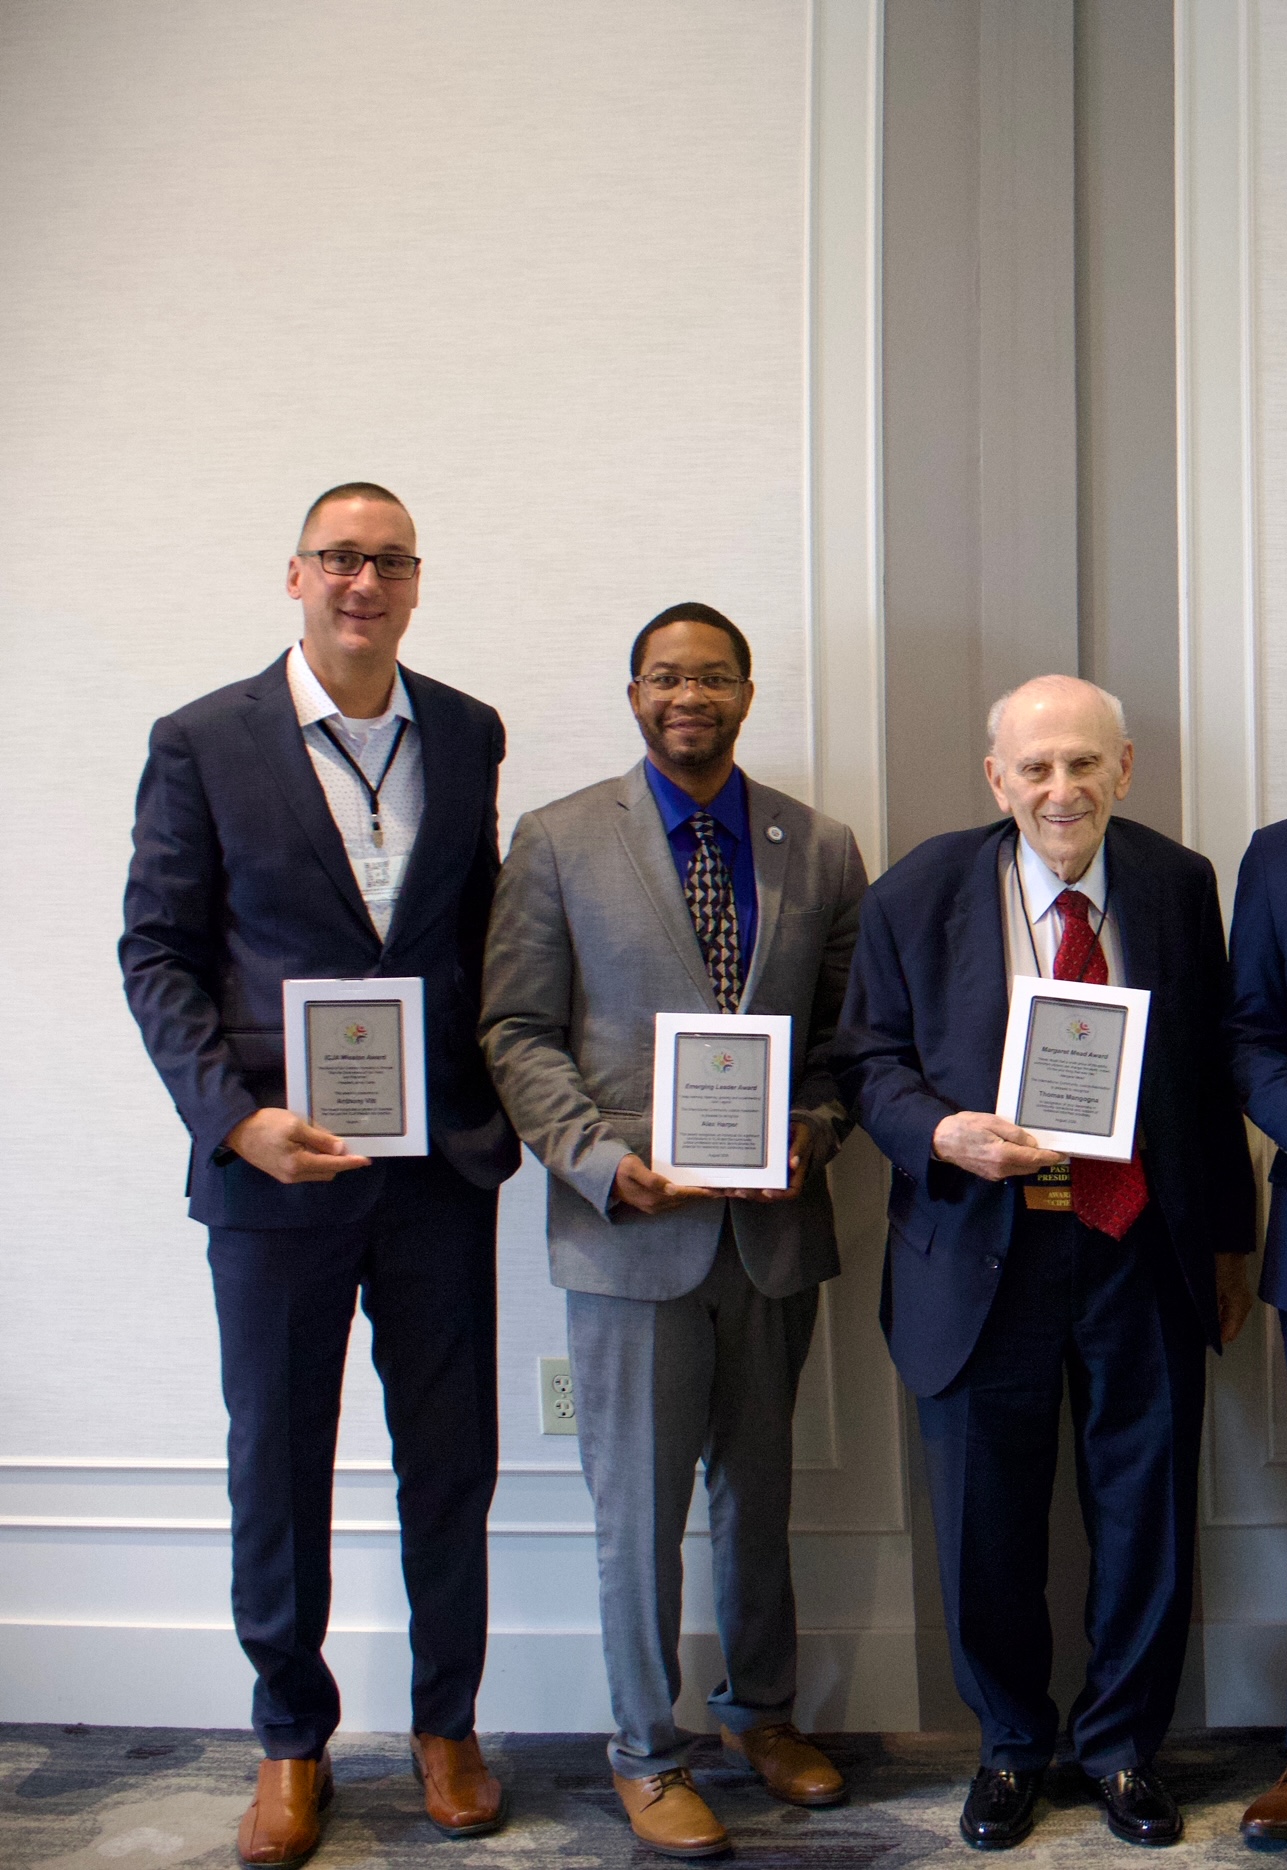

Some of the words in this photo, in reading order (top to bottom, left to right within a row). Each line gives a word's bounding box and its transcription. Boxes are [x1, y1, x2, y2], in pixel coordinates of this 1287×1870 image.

[1042, 1046, 1070, 1055] Margaret
[1088, 1052, 1109, 1060] Award
[1039, 1090, 1064, 1099] Thomas
